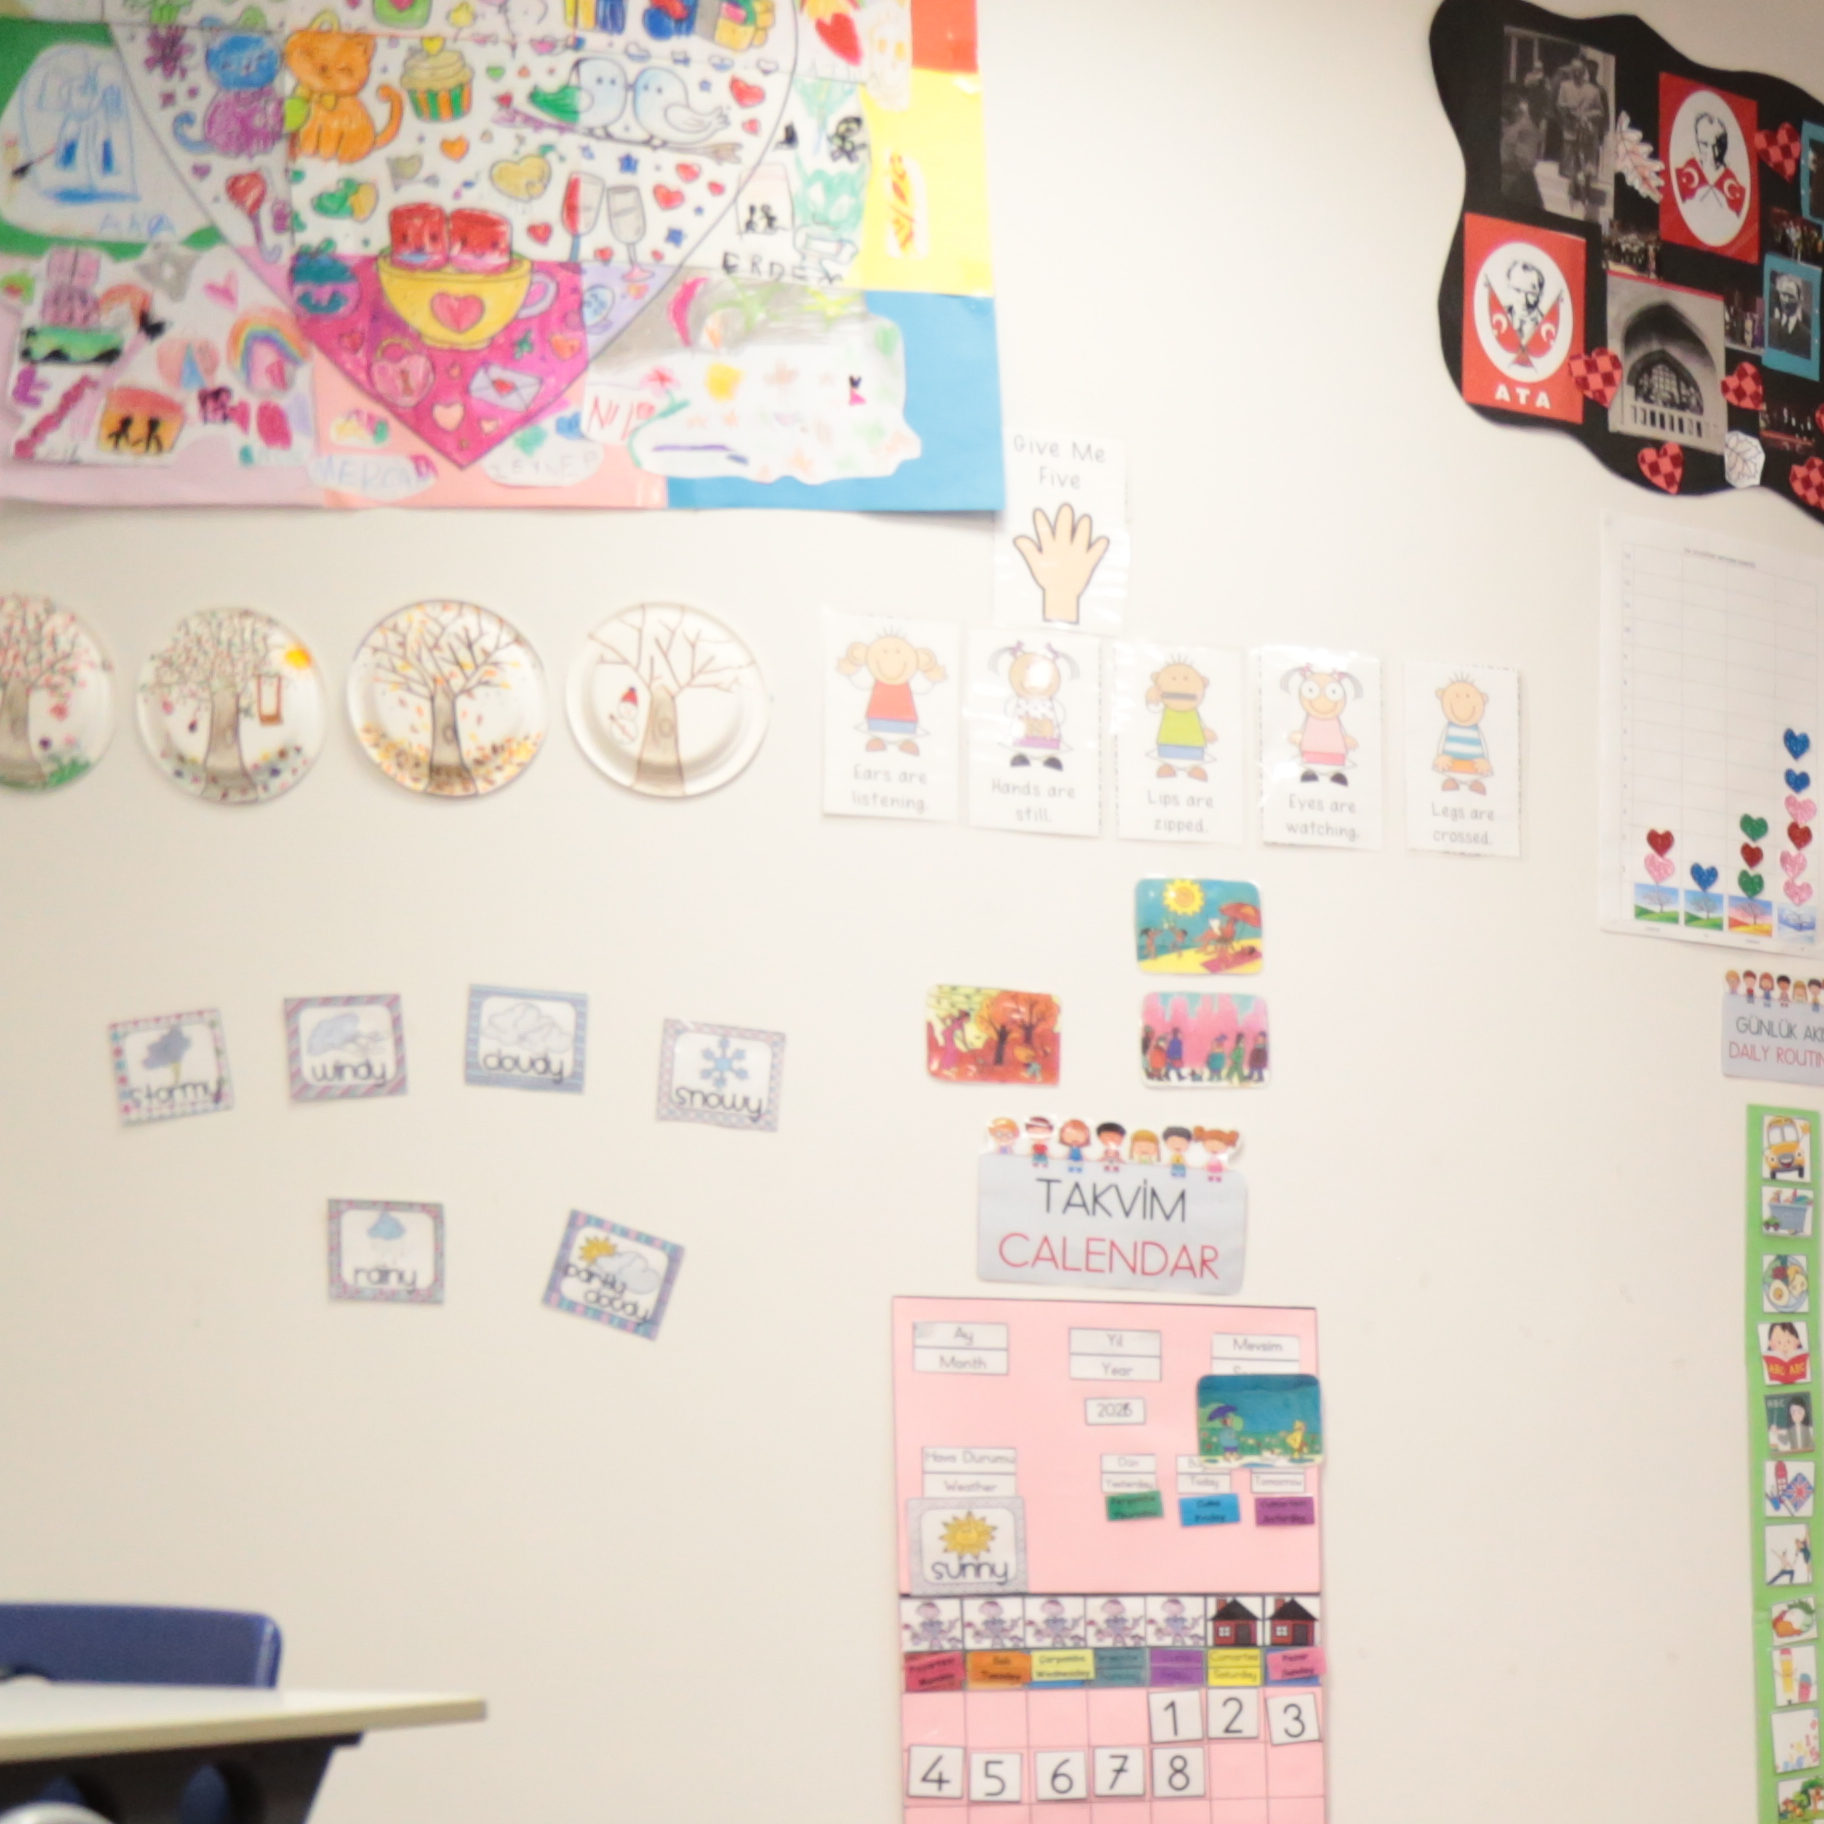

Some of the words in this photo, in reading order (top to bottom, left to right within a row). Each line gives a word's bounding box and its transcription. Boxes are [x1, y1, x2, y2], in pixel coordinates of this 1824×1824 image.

[1495, 385, 1552, 410] ATA
[1013, 434, 1061, 457] Give
[1071, 442, 1106, 464] Me
[1038, 465, 1082, 490] Five
[853, 764, 891, 783] Ears
[898, 768, 928, 785] are
[991, 778, 1041, 798] Hands
[1047, 784, 1076, 800] are
[1147, 790, 1181, 809] Lips
[1186, 794, 1214, 809] are
[1288, 793, 1325, 815] Eyes
[1330, 798, 1357, 815] are
[1430, 801, 1465, 824] Legs
[1470, 805, 1496, 822] are
[1735, 1014, 1799, 1040] GÜNLÜK
[1729, 1039, 1771, 1062] DAILY
[310, 1058, 388, 1087] windy
[674, 1085, 765, 1123] snowy
[1035, 1177, 1187, 1223] TAKVİM
[998, 1232, 1220, 1280] CALENDAR
[353, 1264, 418, 1295] rainy
[953, 1327, 975, 1347] Ay
[1232, 1338, 1283, 1353] Mevsim
[938, 1354, 988, 1371] Month
[1101, 1363, 1133, 1378] Year
[943, 1479, 998, 1494] Weather
[1188, 1474, 1220, 1491] Today
[1253, 1475, 1302, 1488] Tomorrow
[930, 1560, 1009, 1586] sunny
[1162, 1699, 1179, 1737] 1
[1222, 1696, 1244, 1735] 2
[1282, 1702, 1306, 1739] 3
[920, 1753, 951, 1793] 4
[983, 1760, 1006, 1797] 5
[1050, 1758, 1074, 1794] 6
[1108, 1754, 1130, 1791] 7
[1167, 1754, 1190, 1791] 8
